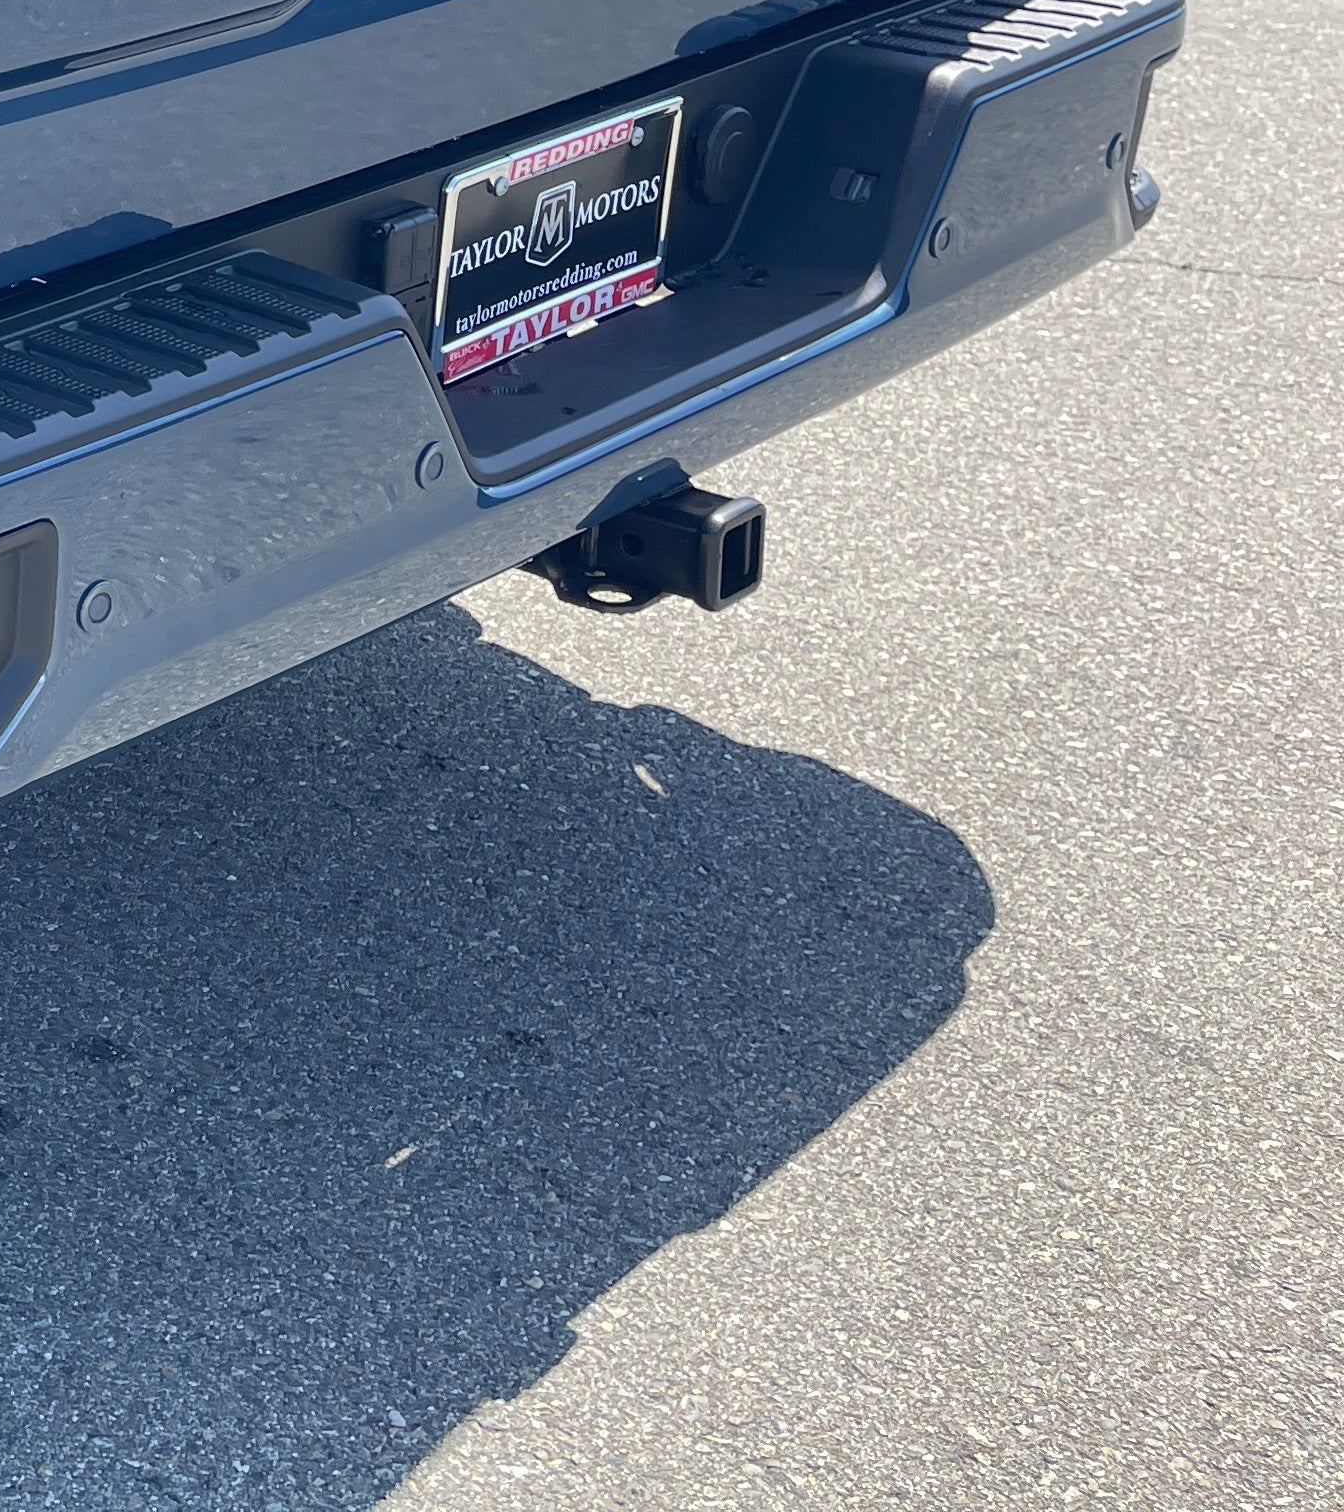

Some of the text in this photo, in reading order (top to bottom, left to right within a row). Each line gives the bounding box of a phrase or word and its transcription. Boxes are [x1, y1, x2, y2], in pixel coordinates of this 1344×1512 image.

[513, 122, 630, 179] REDDING
[449, 224, 525, 278] TAYLOR
[574, 175, 661, 229] MOTORS
[456, 249, 638, 334] taylormotorsredding.com
[491, 284, 615, 356] TAYLOR
[621, 278, 654, 303] GMC
